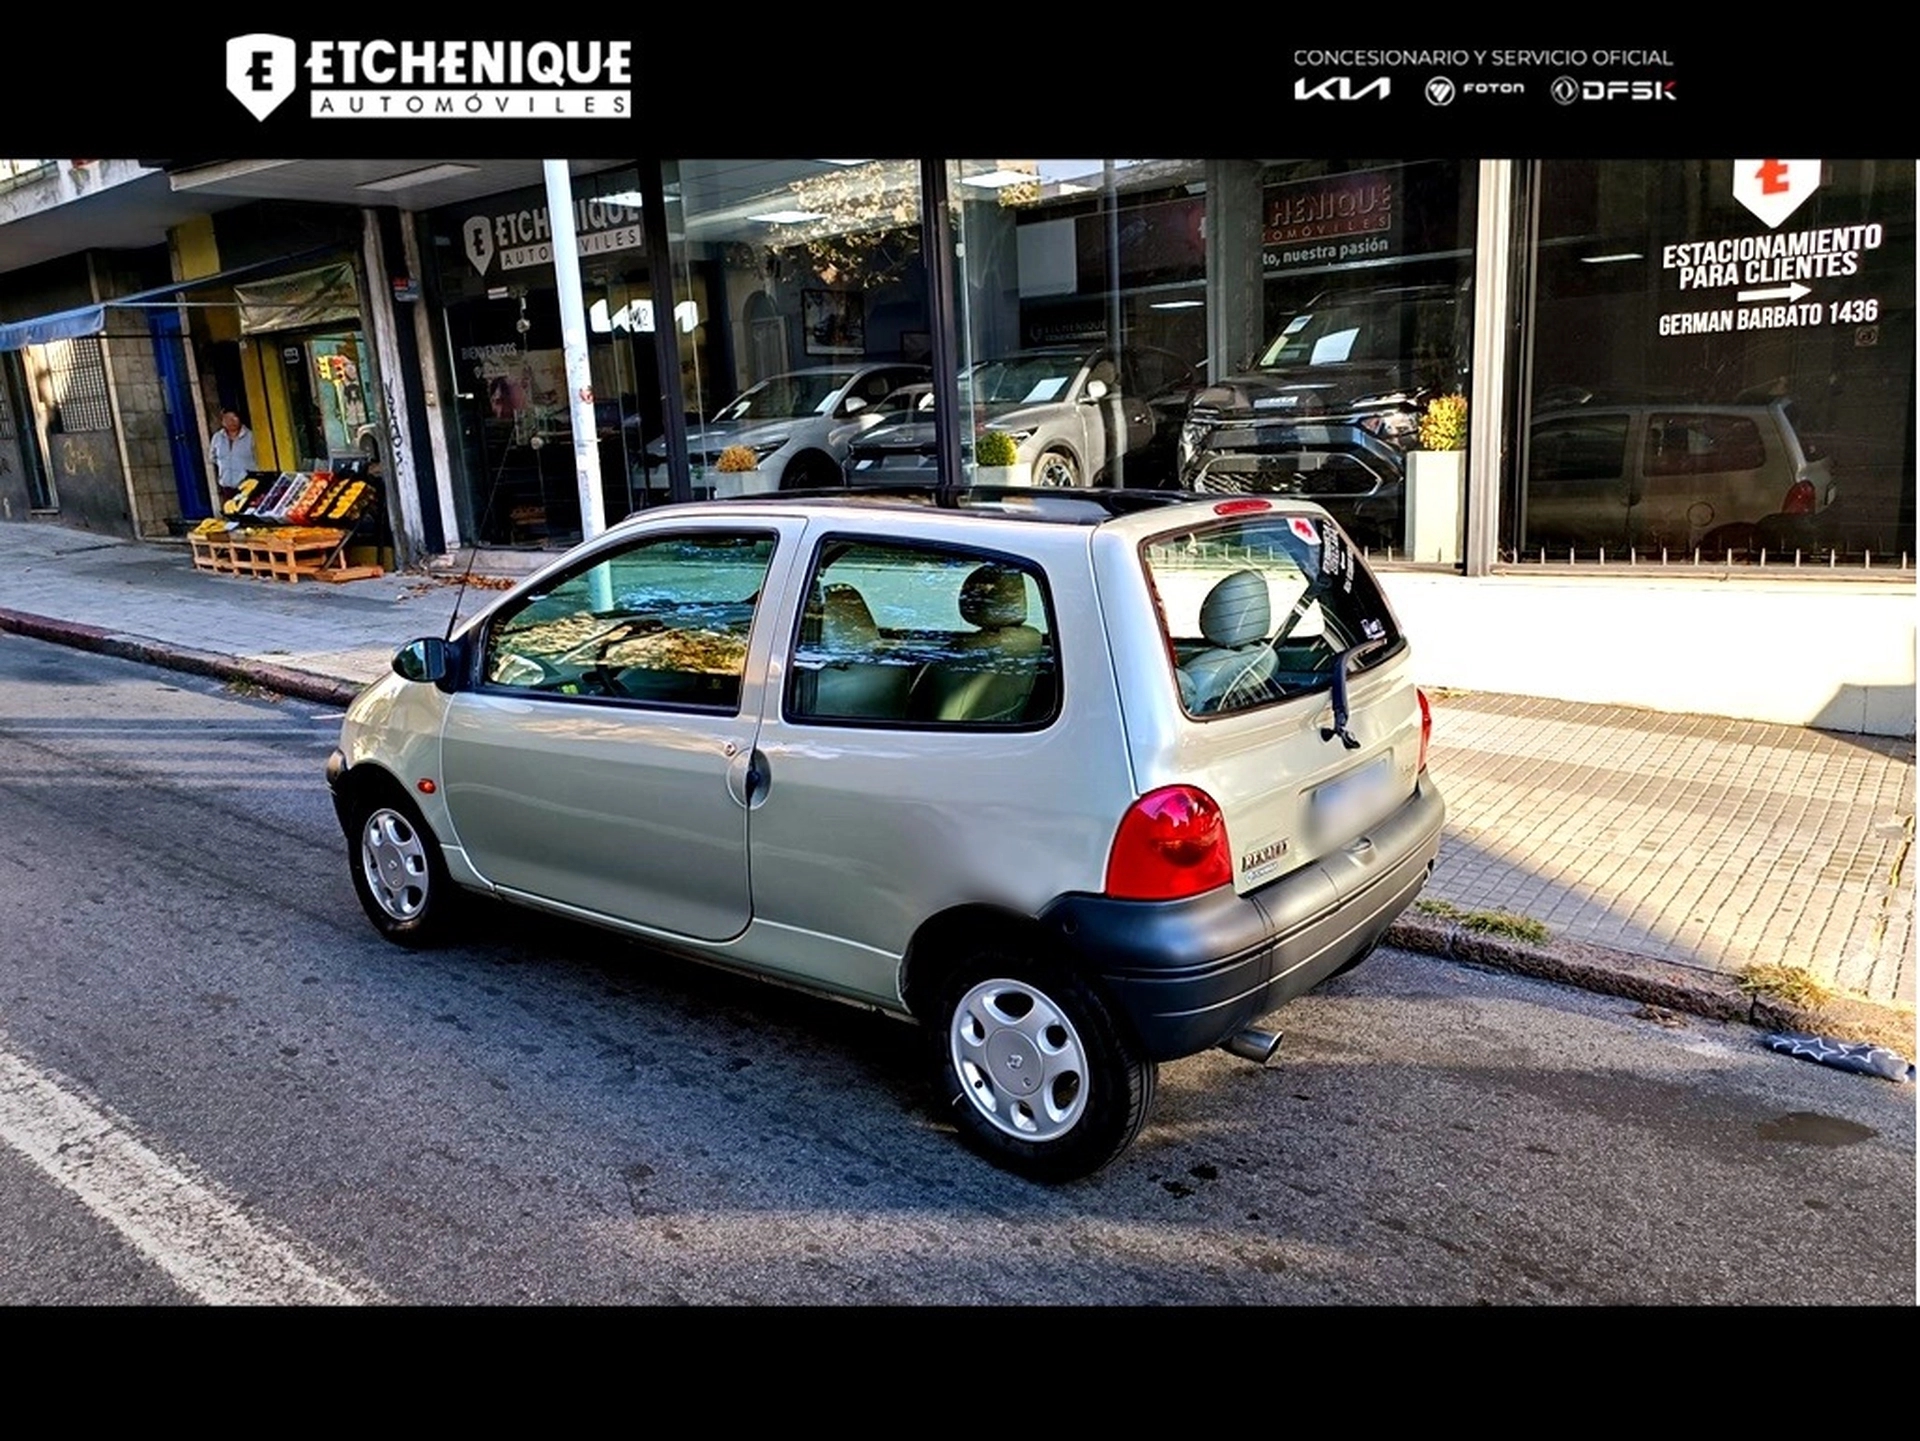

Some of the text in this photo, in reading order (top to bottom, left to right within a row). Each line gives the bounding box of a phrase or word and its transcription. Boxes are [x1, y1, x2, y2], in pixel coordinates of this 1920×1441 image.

[495, 191, 640, 247] ETCHIQU
[1271, 184, 1392, 228] HENIQUE
[1262, 215, 1387, 241] OMÓVILES
[1662, 224, 1882, 269] ESTACIONAMIENTO
[504, 229, 637, 267] AUTOVILES
[1262, 237, 1389, 267] to, nuestra pasión
[1679, 251, 1857, 290] PARA CLIENTES
[1659, 299, 1879, 336] GERMAN BARBATO 1436
